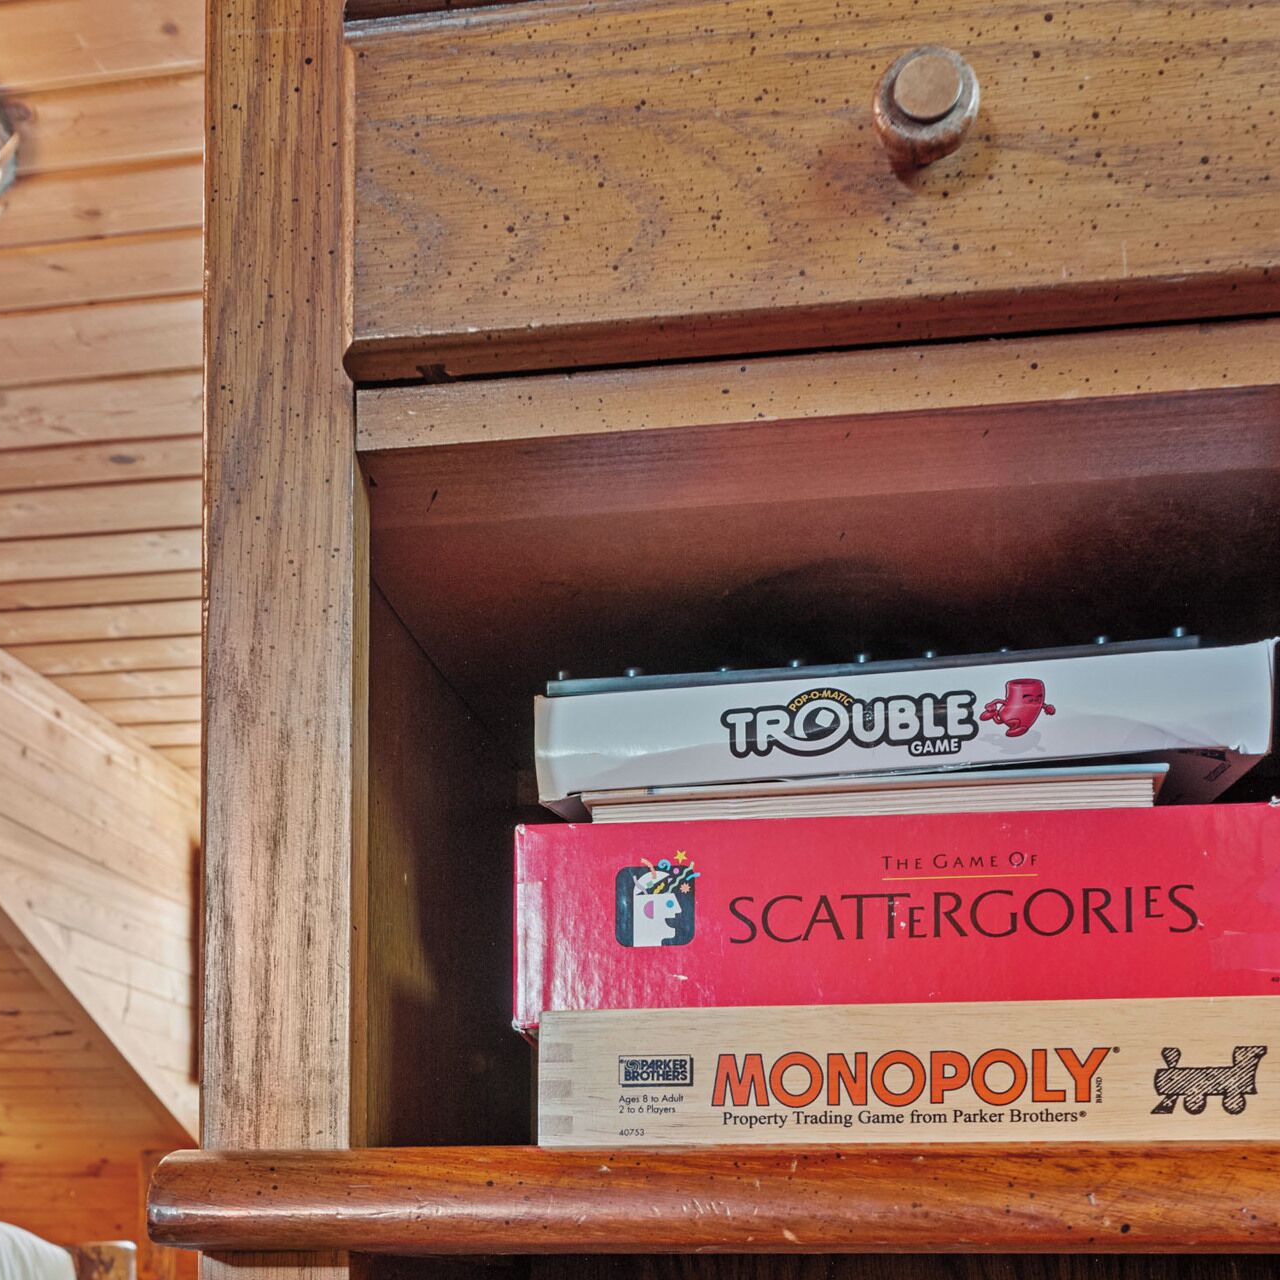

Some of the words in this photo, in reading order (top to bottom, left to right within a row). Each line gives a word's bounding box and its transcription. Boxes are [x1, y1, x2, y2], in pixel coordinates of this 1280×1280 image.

[788, 688, 854, 711] POP-O-MATIC
[724, 692, 976, 755] TROUBLE
[910, 738, 960, 755] GAME
[881, 854, 924, 871] THE
[932, 852, 999, 869] GAME
[1007, 850, 1039, 868] OF
[727, 883, 1201, 945] SCATTERGORIES
[640, 1059, 687, 1070] PARKER
[624, 1070, 688, 1081] BROTHERS
[1095, 1076, 1103, 1104] BRAND
[618, 1095, 640, 1105] Ages
[642, 1095, 649, 1103] 8
[651, 1095, 659, 1103] to
[661, 1094, 684, 1103] Adult
[619, 1105, 624, 1114] 2
[627, 1105, 635, 1114] to
[638, 1105, 644, 1113] 6
[646, 1104, 676, 1115] Players
[722, 1111, 788, 1128] Property
[793, 1110, 853, 1127] Trading
[858, 1110, 905, 1124] Game
[910, 1109, 947, 1124] from
[953, 1108, 1005, 1123] Parker
[618, 1128, 645, 1136] 40753
